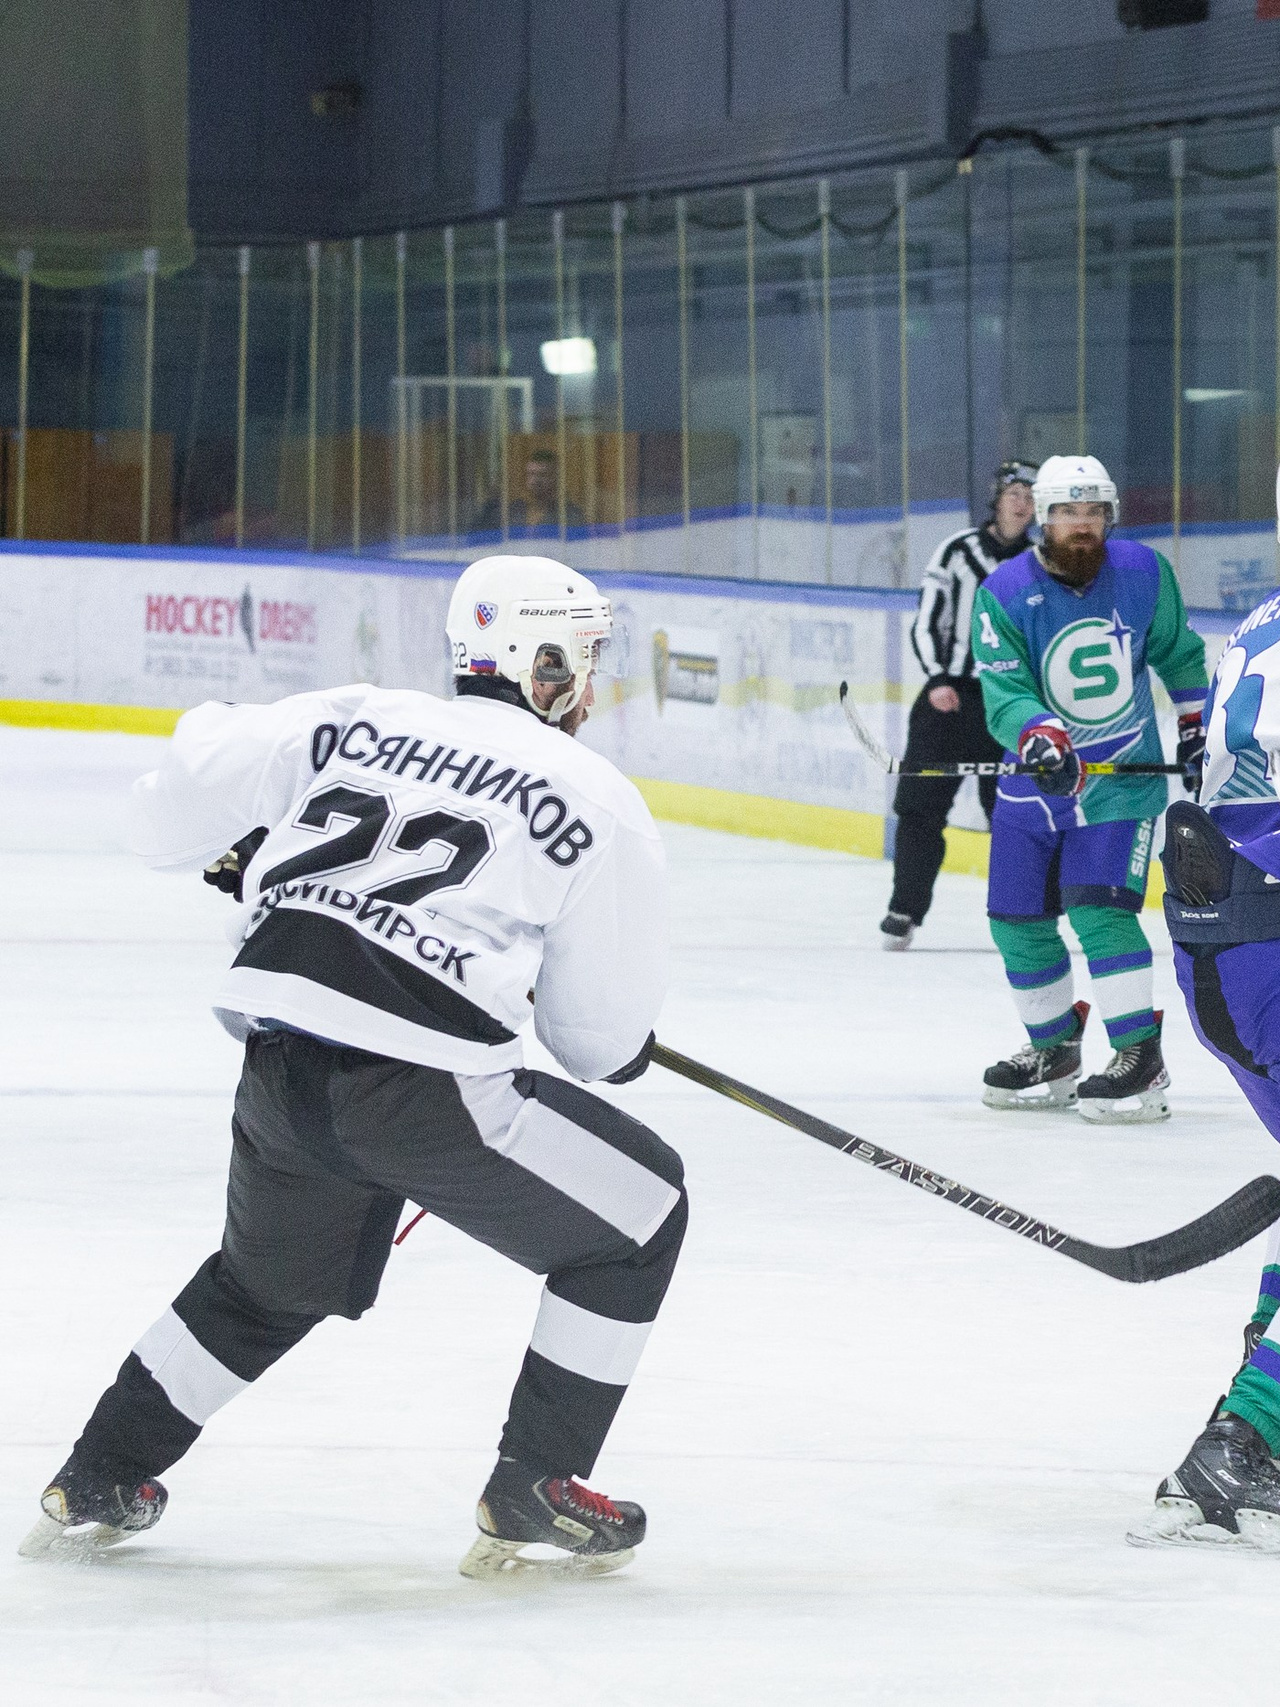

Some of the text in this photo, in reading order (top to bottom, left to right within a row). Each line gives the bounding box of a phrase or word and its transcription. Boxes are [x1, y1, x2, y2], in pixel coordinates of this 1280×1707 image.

[145, 594, 240, 637] HOCKEY
[979, 611, 1000, 649] 4
[310, 720, 596, 869] ОСЯННИКОВ
[957, 762, 1017, 775] CCM
[258, 780, 496, 908] 22
[1130, 817, 1152, 879] SibSt
